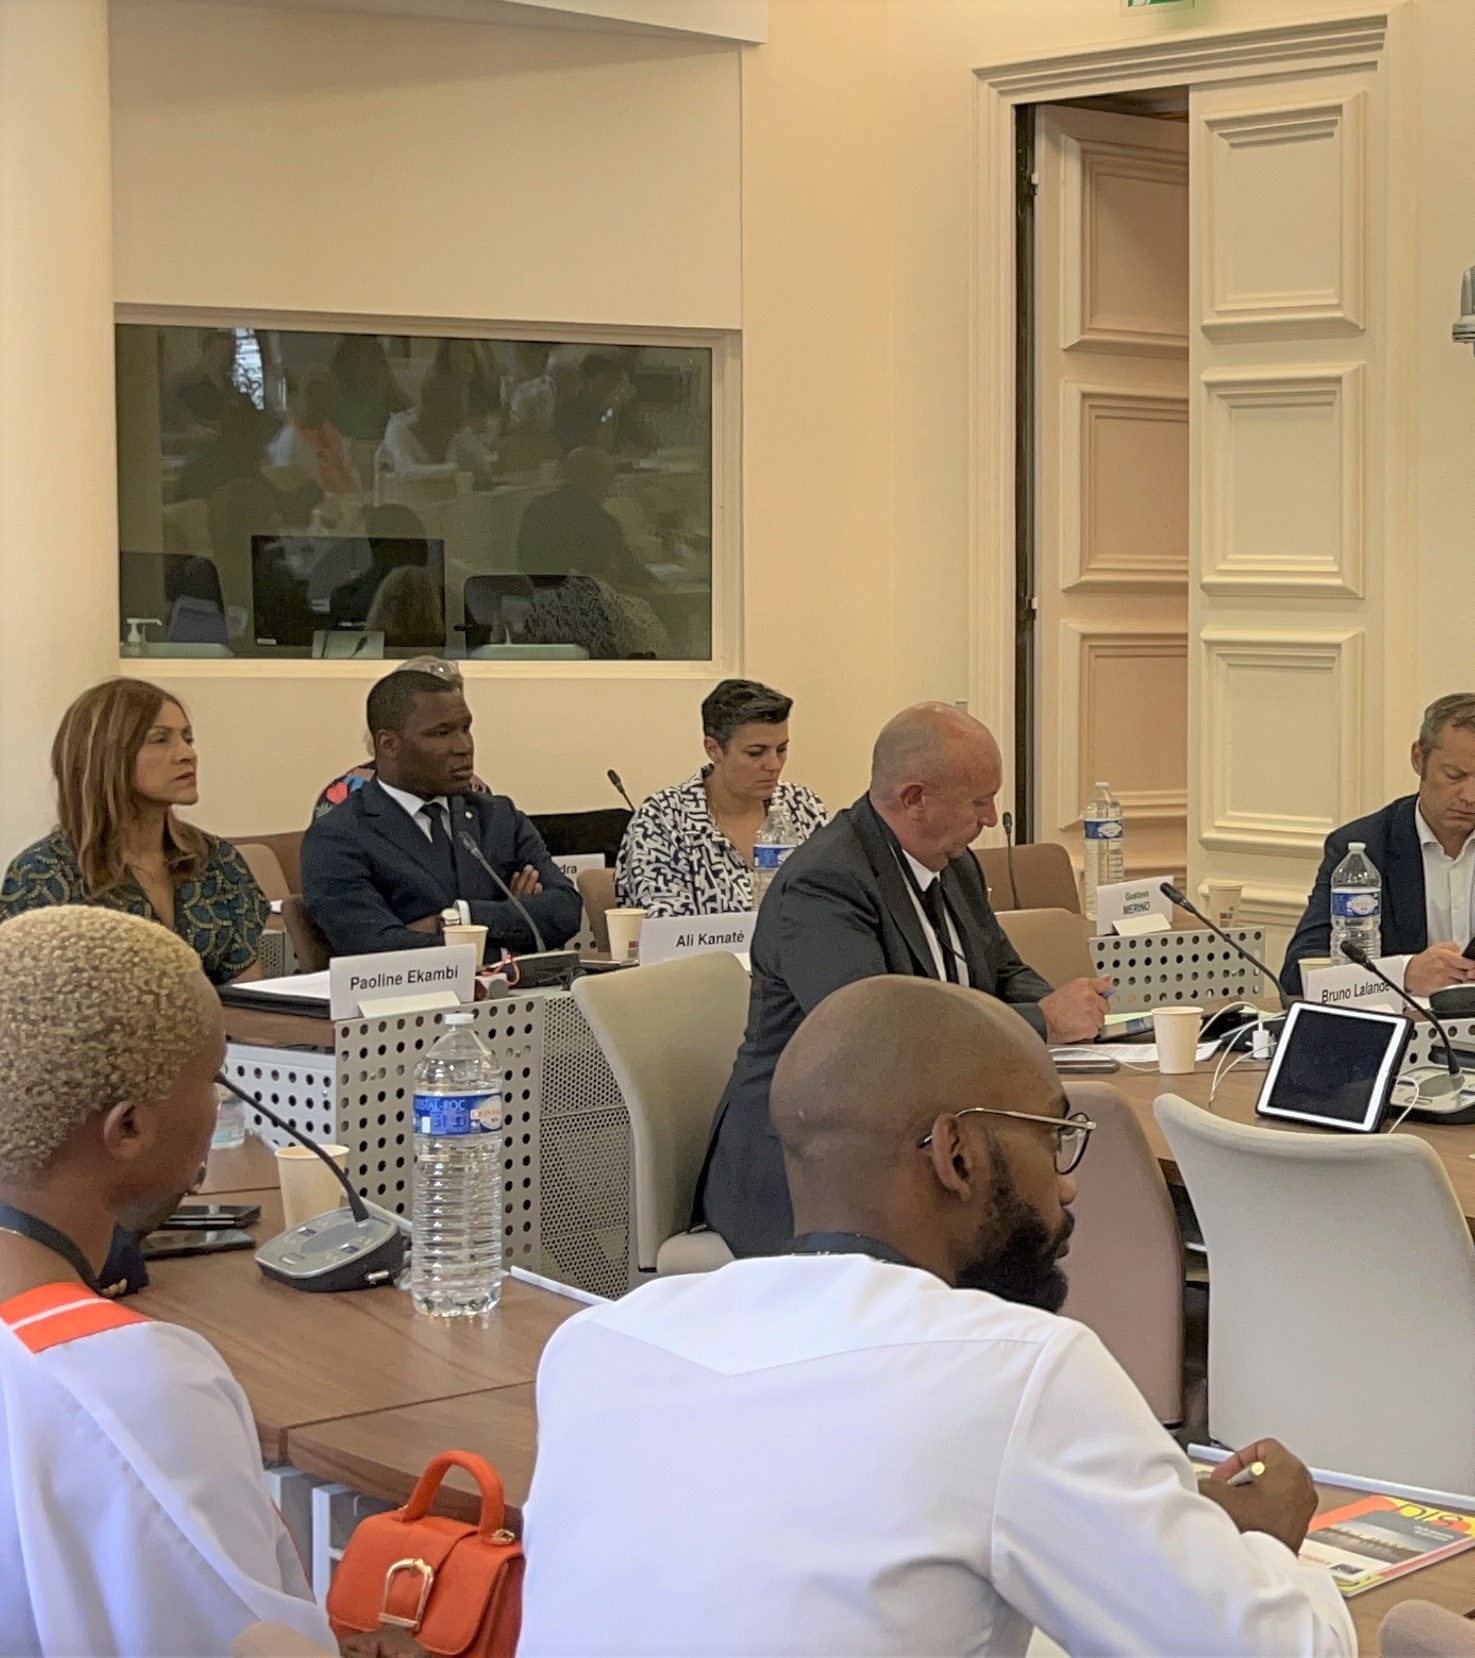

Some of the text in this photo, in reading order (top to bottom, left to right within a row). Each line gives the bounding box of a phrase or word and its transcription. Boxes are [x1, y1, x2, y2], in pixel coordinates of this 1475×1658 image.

[1123, 901, 1150, 915] MERINO
[675, 929, 745, 948] Ali Kanaté
[350, 965, 459, 991] Paoline Ekambi
[1321, 987, 1351, 1003] Bruno
